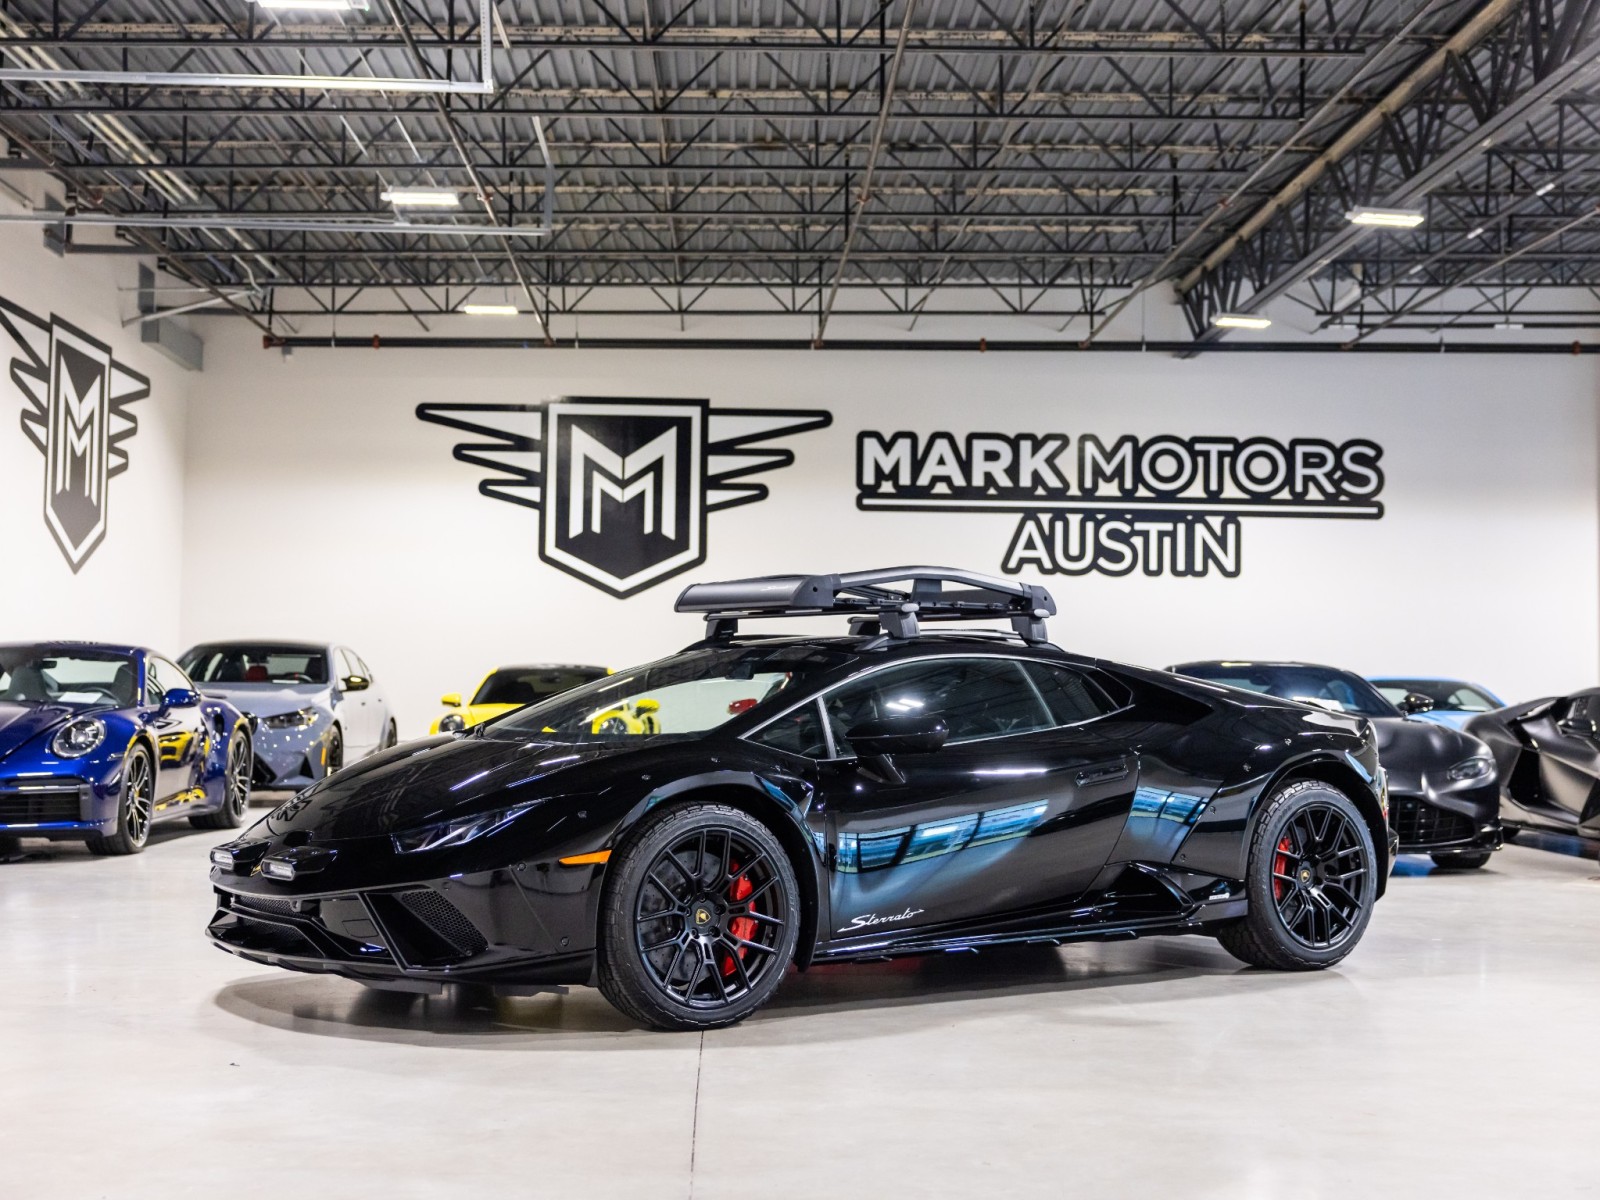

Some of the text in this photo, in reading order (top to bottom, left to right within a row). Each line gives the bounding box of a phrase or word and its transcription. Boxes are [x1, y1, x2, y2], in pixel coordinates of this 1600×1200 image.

[859, 434, 1381, 497] MARK MOTORS
[1005, 516, 1237, 575] AUSTIN
[836, 907, 925, 933] Sterrato
